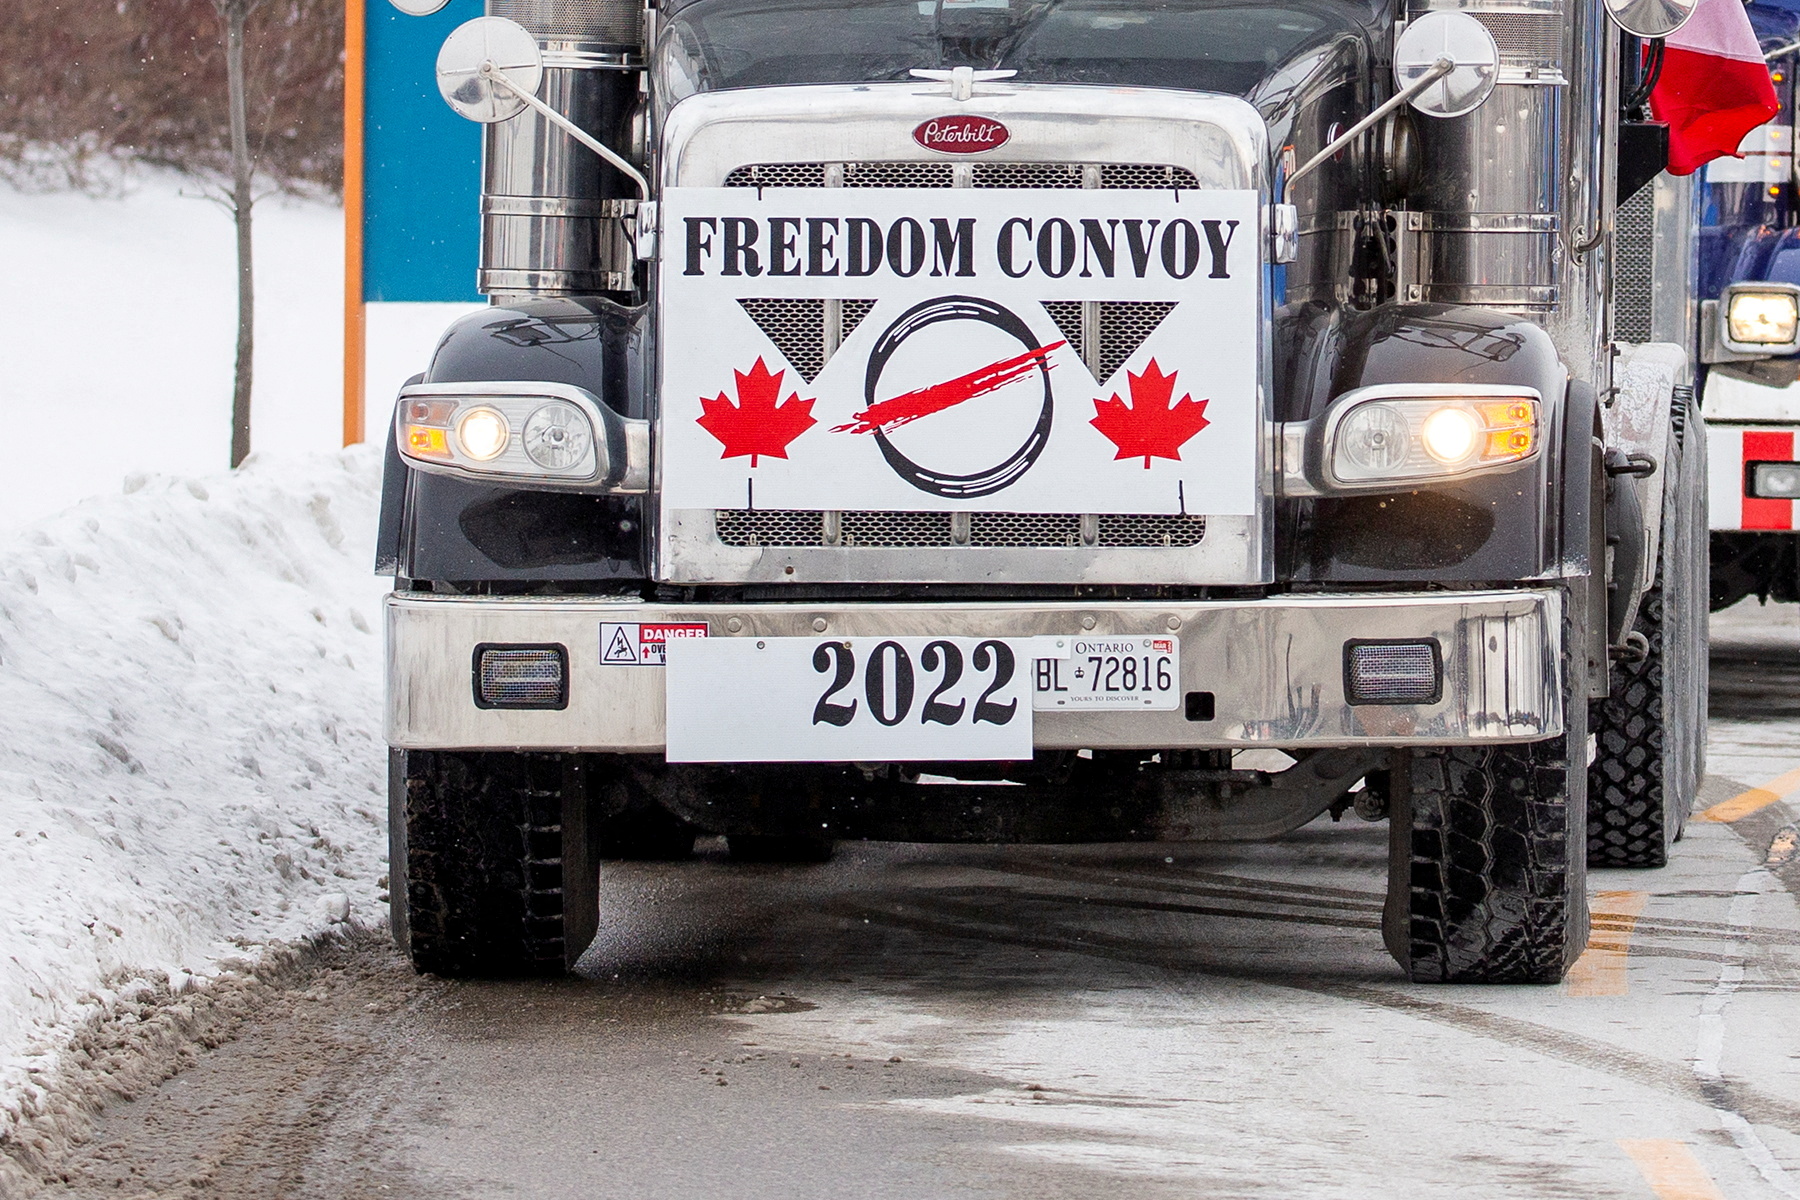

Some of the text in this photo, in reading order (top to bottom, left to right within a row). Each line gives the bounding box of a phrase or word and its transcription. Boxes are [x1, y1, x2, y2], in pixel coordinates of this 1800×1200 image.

[923, 121, 1002, 144] Peterbilt
[682, 216, 1241, 279] FREEDOM CONVOY
[643, 628, 706, 640] DANGER
[1075, 641, 1134, 655] ONTARIO
[811, 639, 1018, 728] 2022
[1036, 656, 1172, 692] BL 72816
